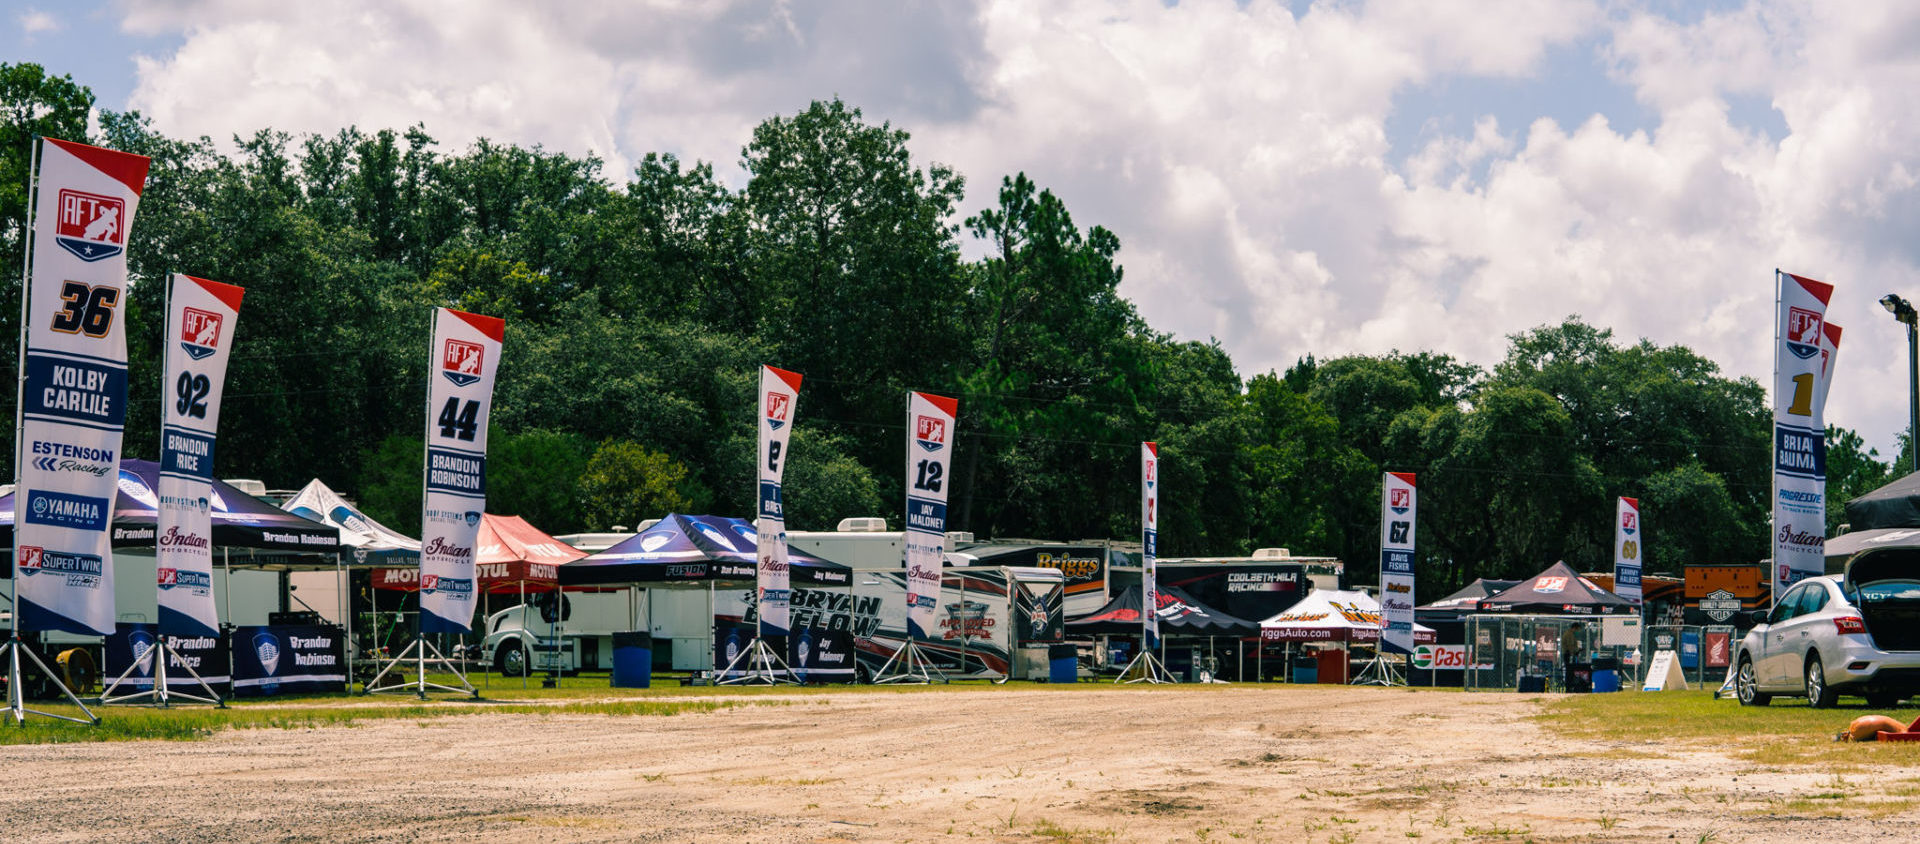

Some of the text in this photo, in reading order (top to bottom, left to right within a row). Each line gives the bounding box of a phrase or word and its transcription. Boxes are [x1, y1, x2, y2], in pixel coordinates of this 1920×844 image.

[63, 195, 100, 226] AFT
[50, 280, 120, 339] 36
[53, 364, 108, 392] KOLBY
[44, 388, 110, 417] CARLILE
[177, 371, 210, 420] 92
[1787, 373, 1814, 416] 1
[438, 396, 480, 442] 44
[33, 440, 113, 463] ESTENSON
[1780, 450, 1816, 471] BAUMA
[58, 461, 111, 478] Racing
[432, 454, 480, 474] BRANDON
[431, 470, 480, 489] ROBINSON
[915, 459, 943, 493] 12
[37, 513, 94, 524] RACING
[49, 500, 99, 519] YAMAHA
[921, 503, 934, 516] JAY
[910, 513, 943, 529] MALONEY
[114, 527, 154, 540] Brandon
[160, 525, 208, 549] Indian
[263, 532, 299, 543] Brandon
[1779, 524, 1824, 547] Indian
[426, 537, 471, 557] Indian
[384, 569, 420, 583] MOT
[530, 564, 559, 579] MOTUL
[665, 563, 708, 577] FUSION
[1037, 553, 1100, 580] Briggs
[1228, 583, 1263, 592] RACING
[789, 587, 883, 619] BRYAN
[939, 618, 996, 628] APPOVED
[168, 636, 216, 650] Brandon
[1260, 629, 1331, 640] riggsAuto.com
[1352, 629, 1381, 640] BriggsAuto.c
[820, 638, 832, 651] Jay
[170, 653, 201, 667] Price
